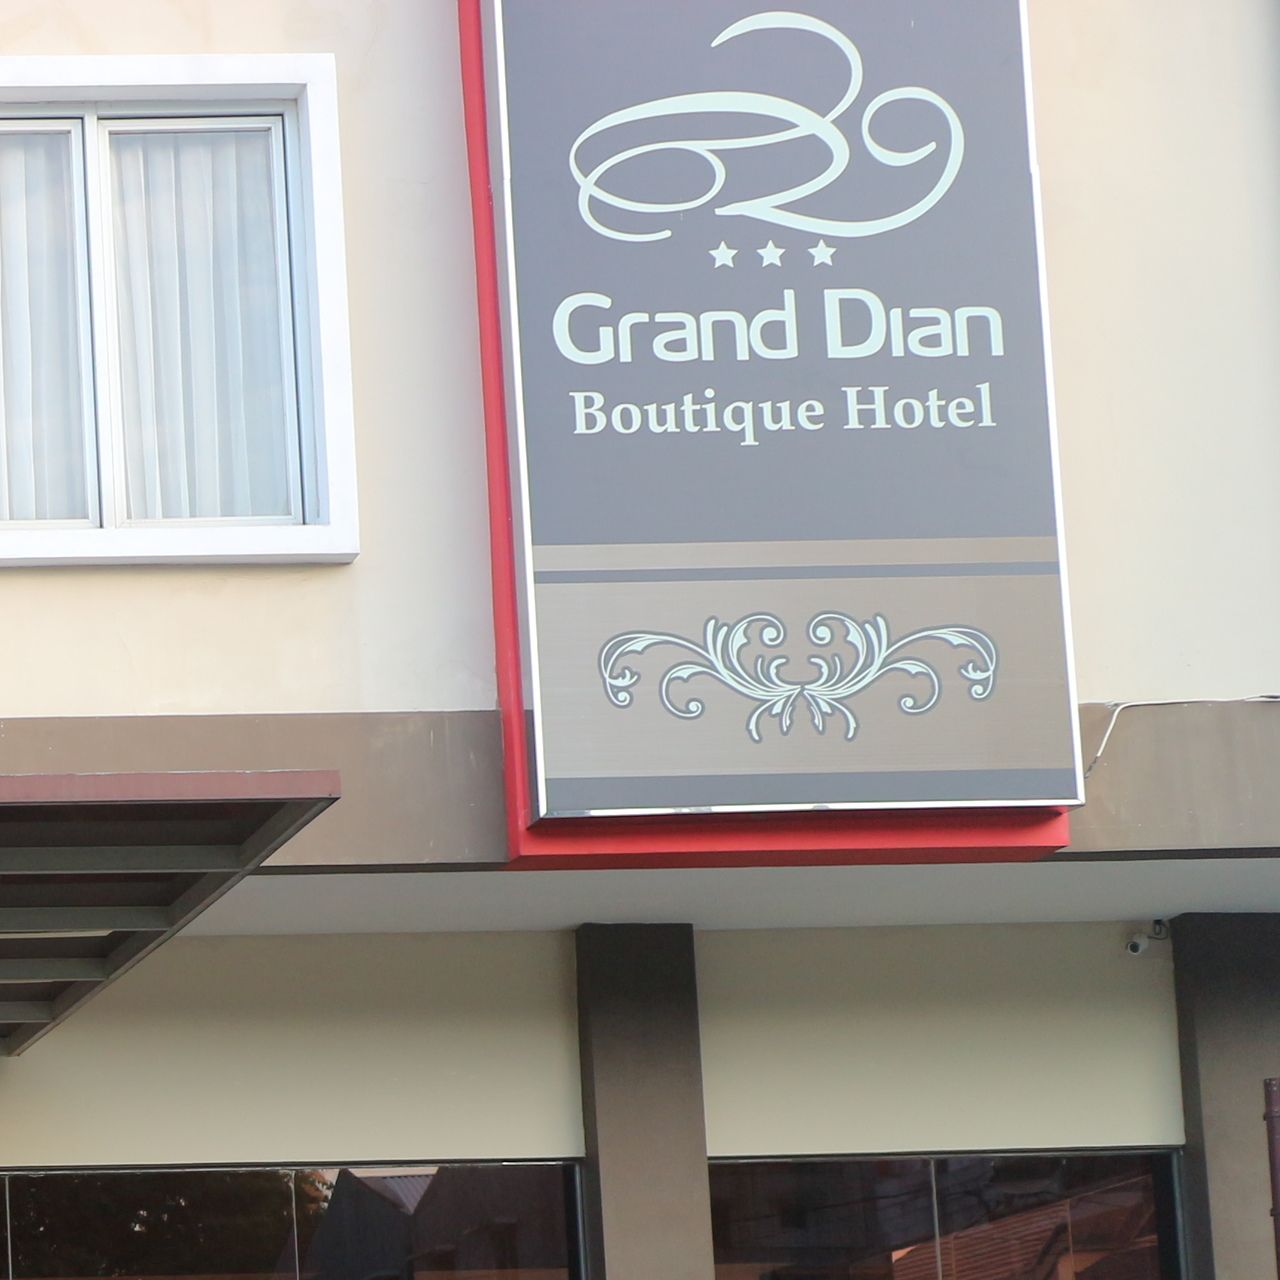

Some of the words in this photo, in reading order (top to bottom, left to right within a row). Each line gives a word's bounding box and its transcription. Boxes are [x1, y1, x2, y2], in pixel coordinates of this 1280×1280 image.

[552, 289, 799, 364] Grand
[823, 288, 1004, 359] Dian
[569, 388, 825, 446] Boutique
[842, 382, 997, 430] Hotel
